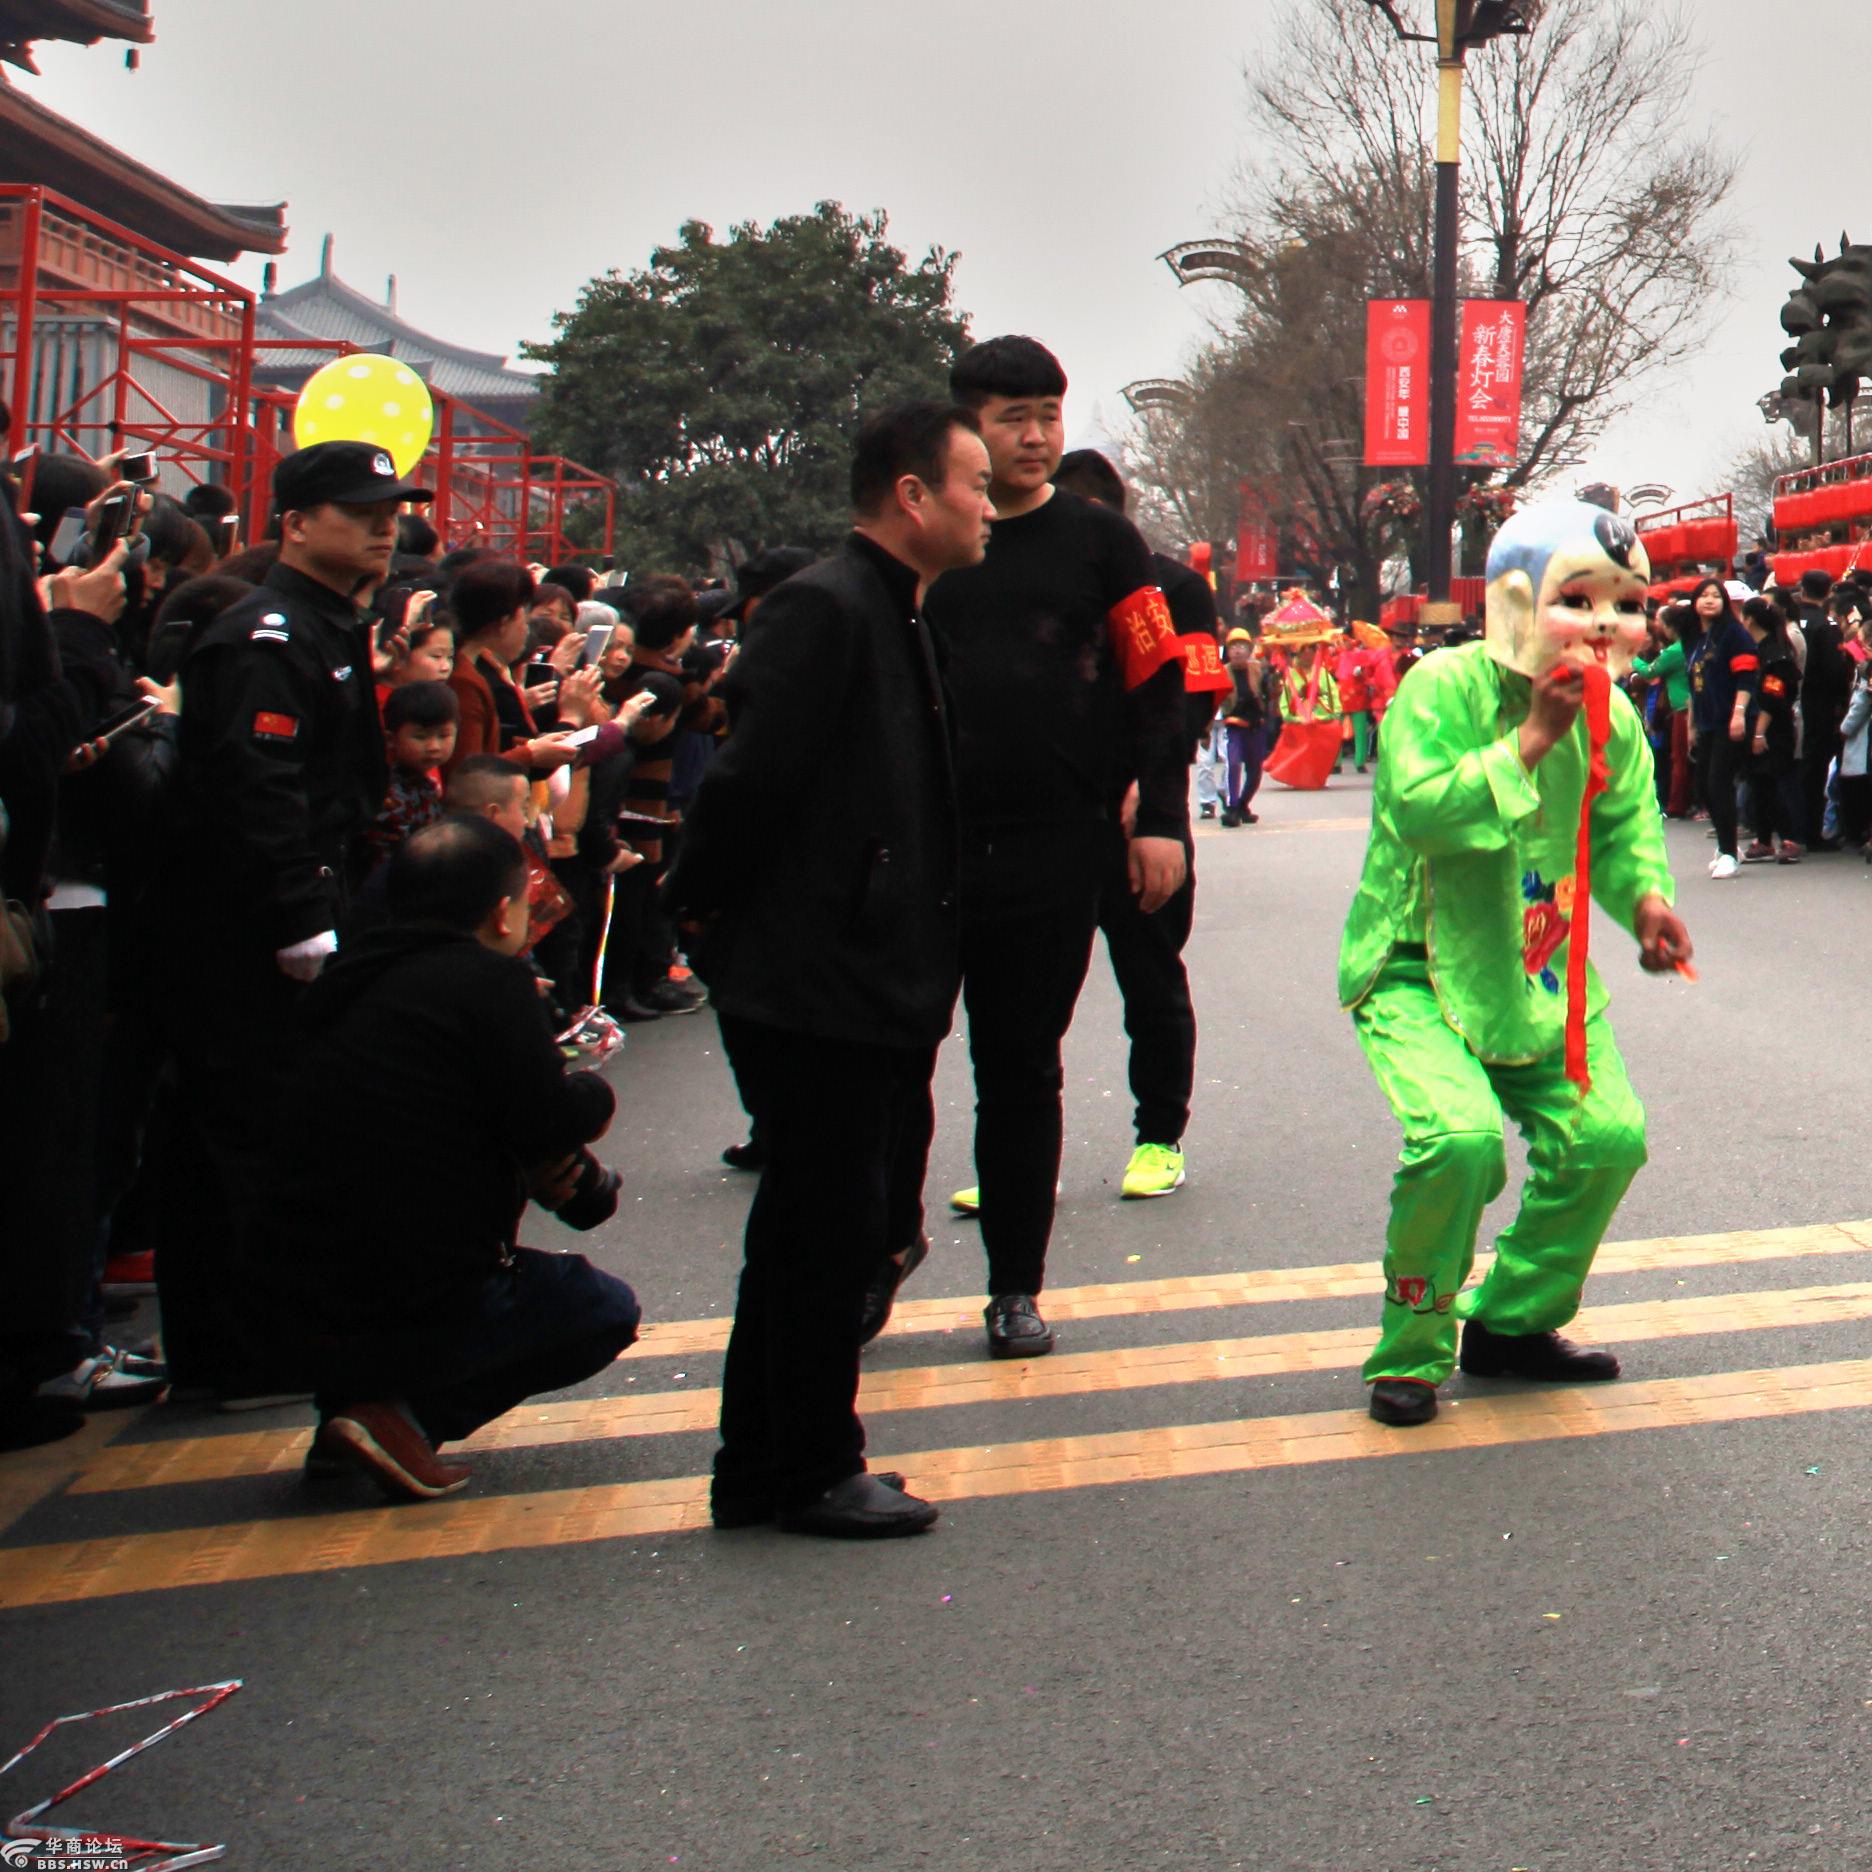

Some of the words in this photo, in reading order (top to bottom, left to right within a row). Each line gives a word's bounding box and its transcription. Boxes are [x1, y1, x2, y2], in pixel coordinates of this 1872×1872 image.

[1468, 324, 1497, 410] 新春灯会
[1125, 598, 1176, 655] 治安
